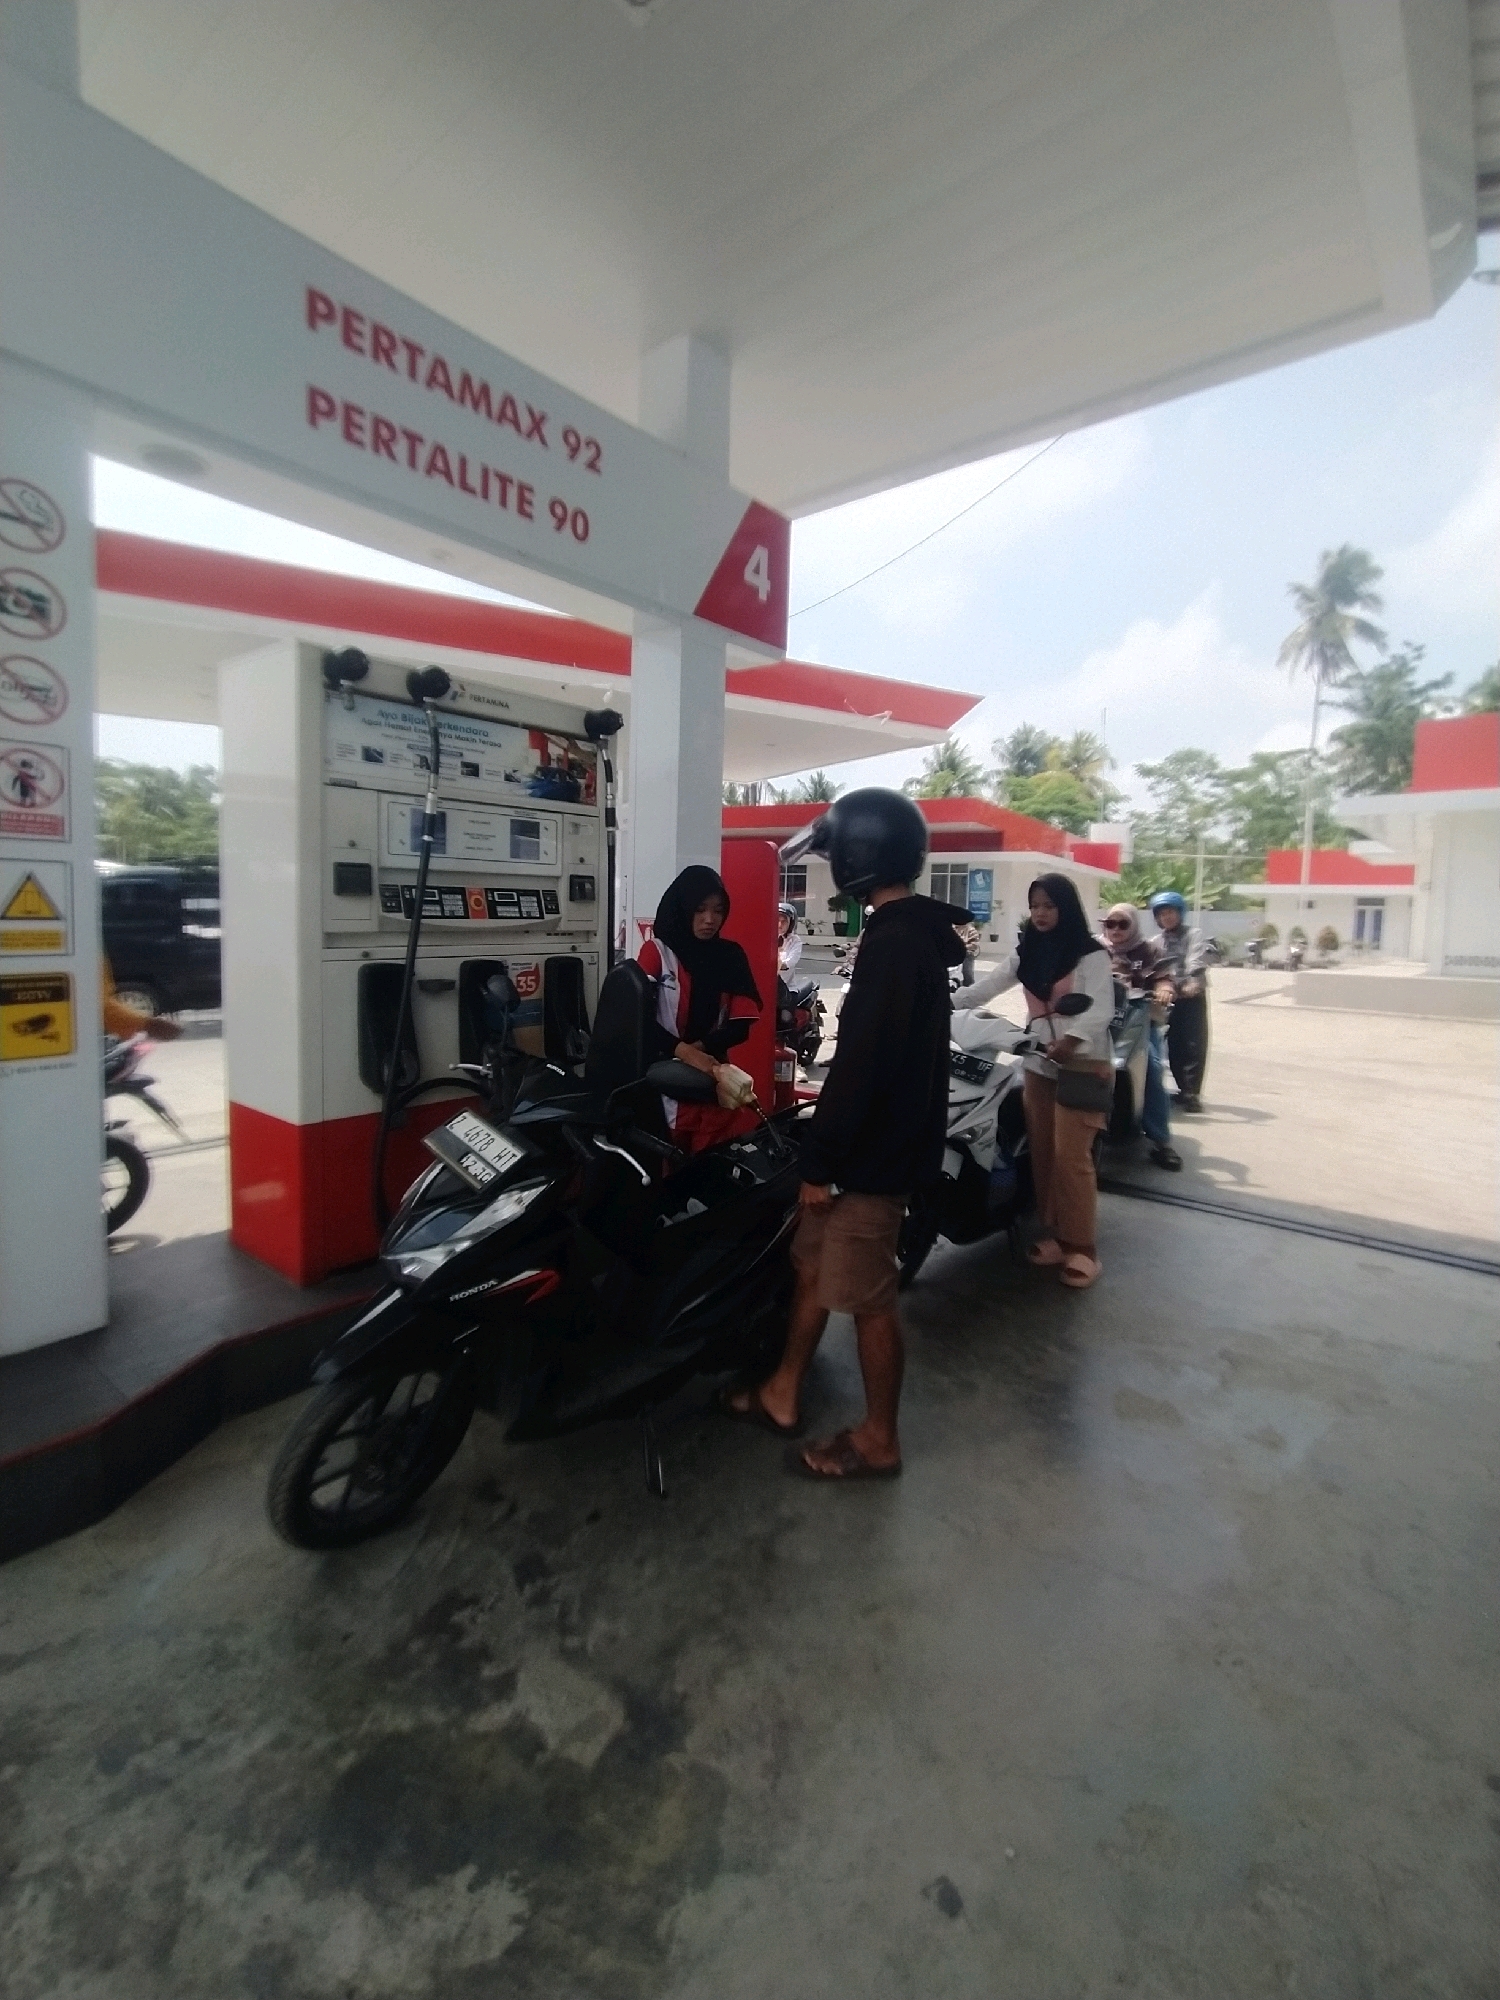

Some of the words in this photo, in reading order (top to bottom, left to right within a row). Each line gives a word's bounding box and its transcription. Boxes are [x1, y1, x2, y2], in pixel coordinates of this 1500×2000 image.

[305, 285, 549, 449] PERTAMAX
[561, 424, 604, 475] 92
[305, 384, 535, 521] PERTALITE
[548, 495, 591, 545] 90
[744, 544, 771, 601] 4
[469, 693, 509, 709] PERTAMINA
[377, 709, 398, 721] Ayo
[401, 712, 428, 725] Bijak
[437, 720, 489, 738] erkendara
[517, 976, 536, 993] 35
[449, 1115, 467, 1130] Z
[463, 1125, 496, 1152] 4678
[491, 1147, 518, 1168] HT
[449, 1278, 499, 1303] HONDA
